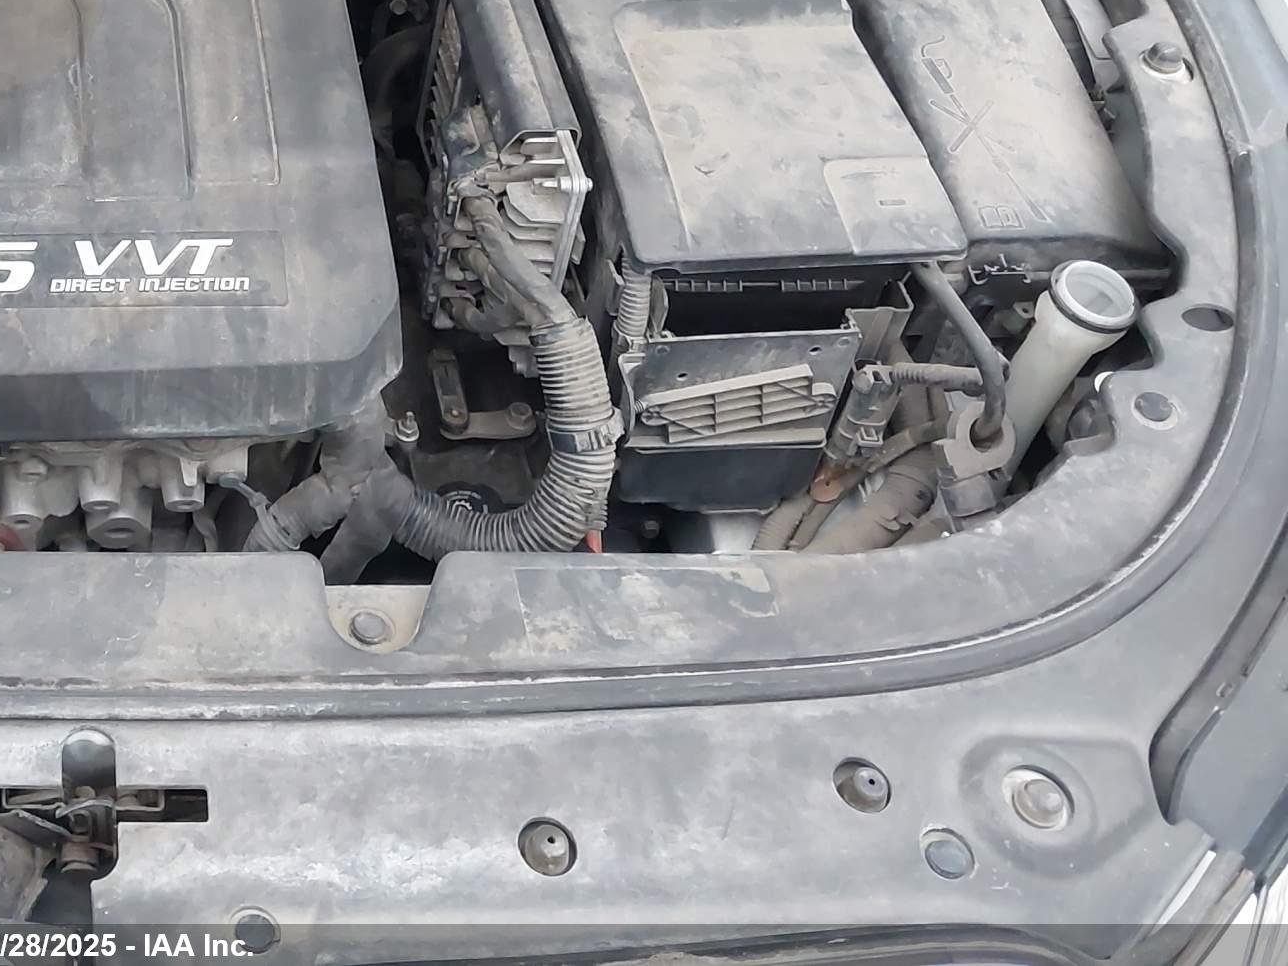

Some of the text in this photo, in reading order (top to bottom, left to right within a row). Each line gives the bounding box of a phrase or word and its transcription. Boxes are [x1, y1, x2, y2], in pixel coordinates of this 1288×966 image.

[74, 238, 234, 275] VVT
[49, 277, 250, 293] DIRECT INJECTION
